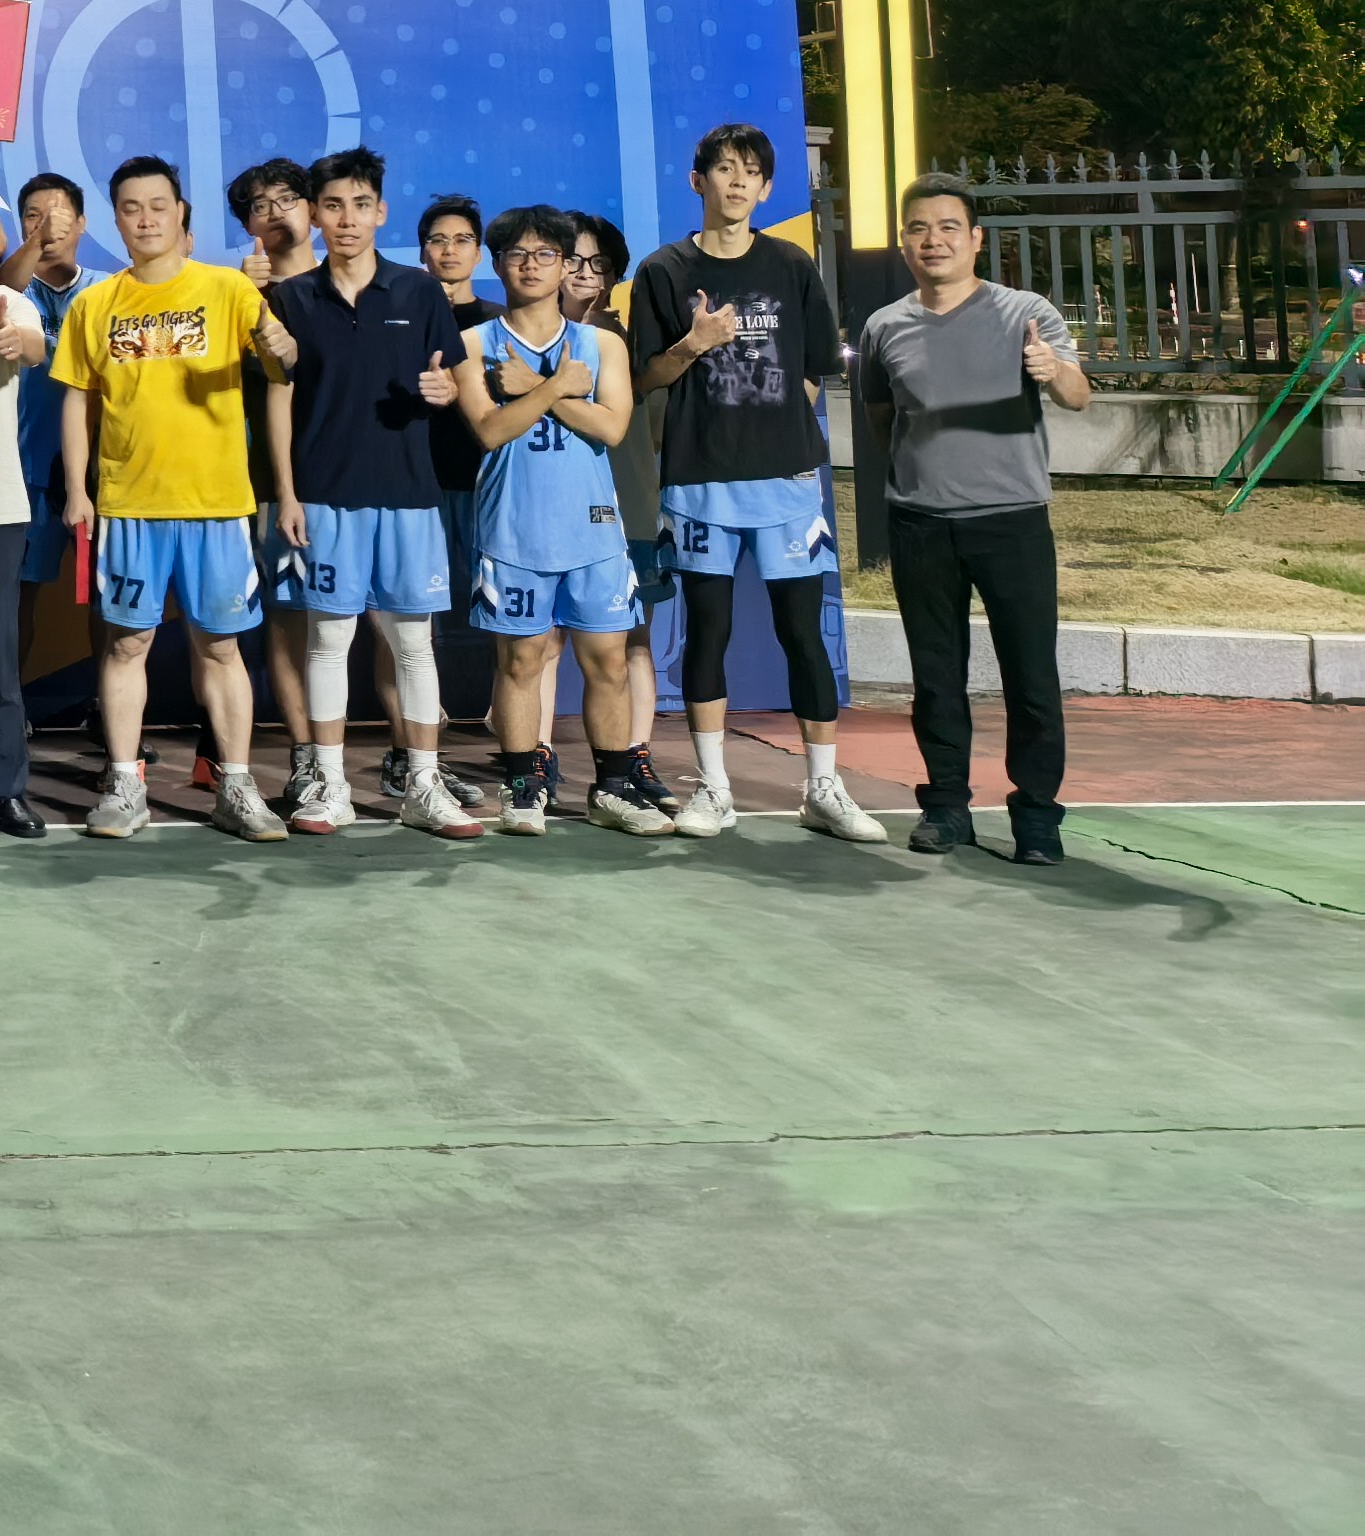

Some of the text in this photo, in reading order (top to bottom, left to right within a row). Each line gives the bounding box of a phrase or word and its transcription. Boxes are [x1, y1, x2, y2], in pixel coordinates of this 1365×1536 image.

[108, 306, 206, 339] LET'S GO TIGERS
[745, 314, 779, 329] LOVE
[528, 416, 565, 452] 31
[682, 522, 709, 554] 12
[110, 574, 145, 609] 77
[307, 561, 336, 594] 13
[504, 586, 535, 618] 31
